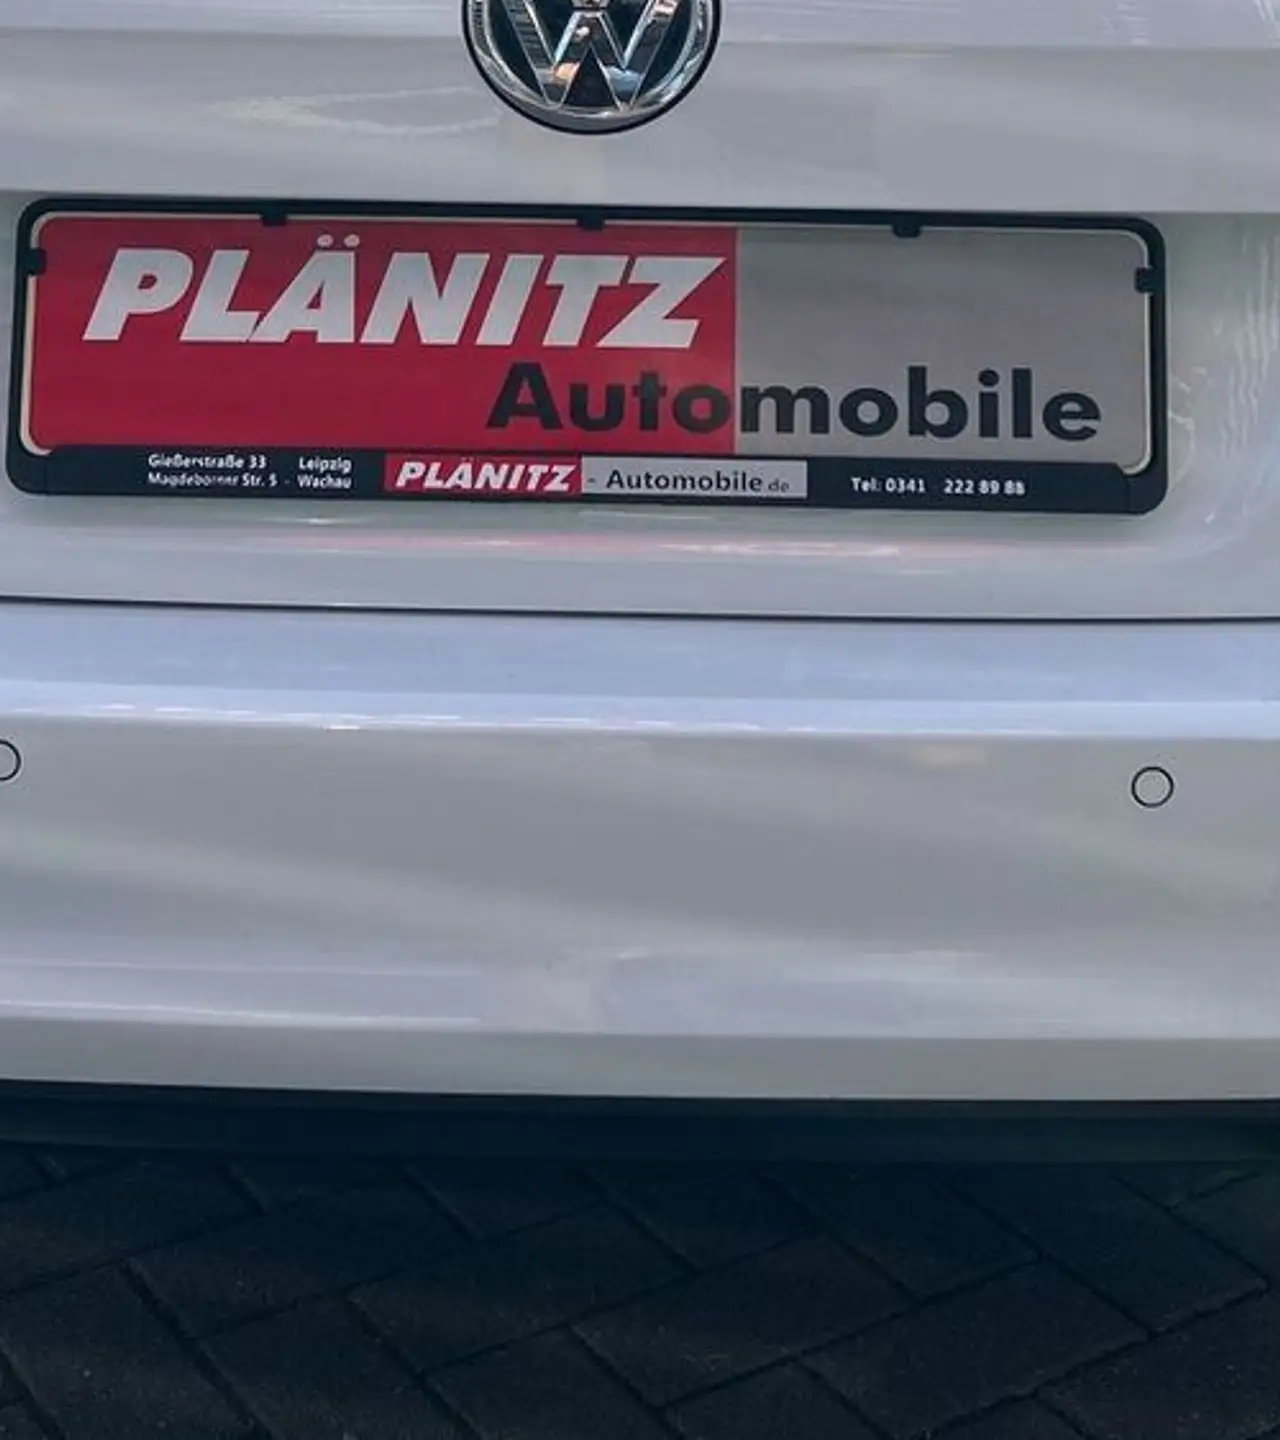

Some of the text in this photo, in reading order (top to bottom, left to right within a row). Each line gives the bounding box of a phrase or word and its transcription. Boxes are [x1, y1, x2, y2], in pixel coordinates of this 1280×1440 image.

[82, 231, 726, 350] PLÄNITZ
[485, 361, 1102, 442] Automobile
[248, 454, 267, 469] 33
[299, 456, 352, 473] Leipzig
[297, 474, 352, 490] Wachau
[395, 458, 577, 491] PLÄNITZ
[885, 477, 926, 494] 0341
[943, 478, 975, 495] 222
